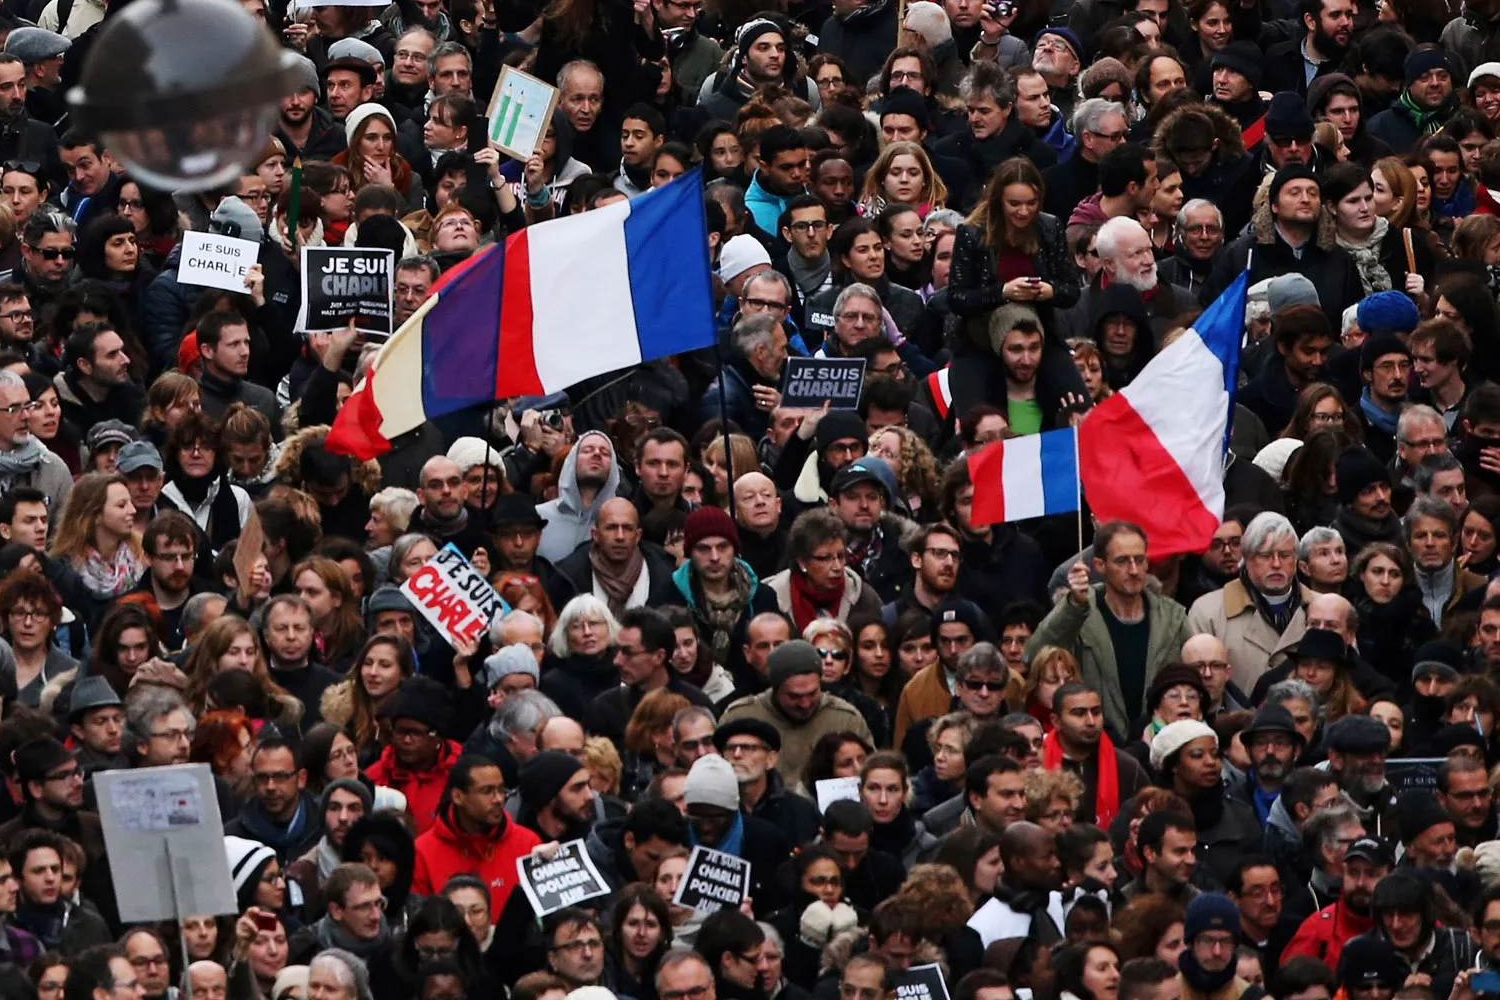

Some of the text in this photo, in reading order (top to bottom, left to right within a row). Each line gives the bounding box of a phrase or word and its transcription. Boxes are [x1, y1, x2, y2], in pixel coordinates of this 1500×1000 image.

[198, 243, 241, 258] JE SUIS
[321, 257, 388, 274] JE SUI
[321, 275, 388, 297] CHARLI
[791, 367, 860, 381] JE SUIS
[788, 379, 857, 398] CHARLIE
[437, 547, 503, 620] JE SUIS
[698, 863, 742, 888] CHARLIE
[690, 877, 742, 905] POLICIER
